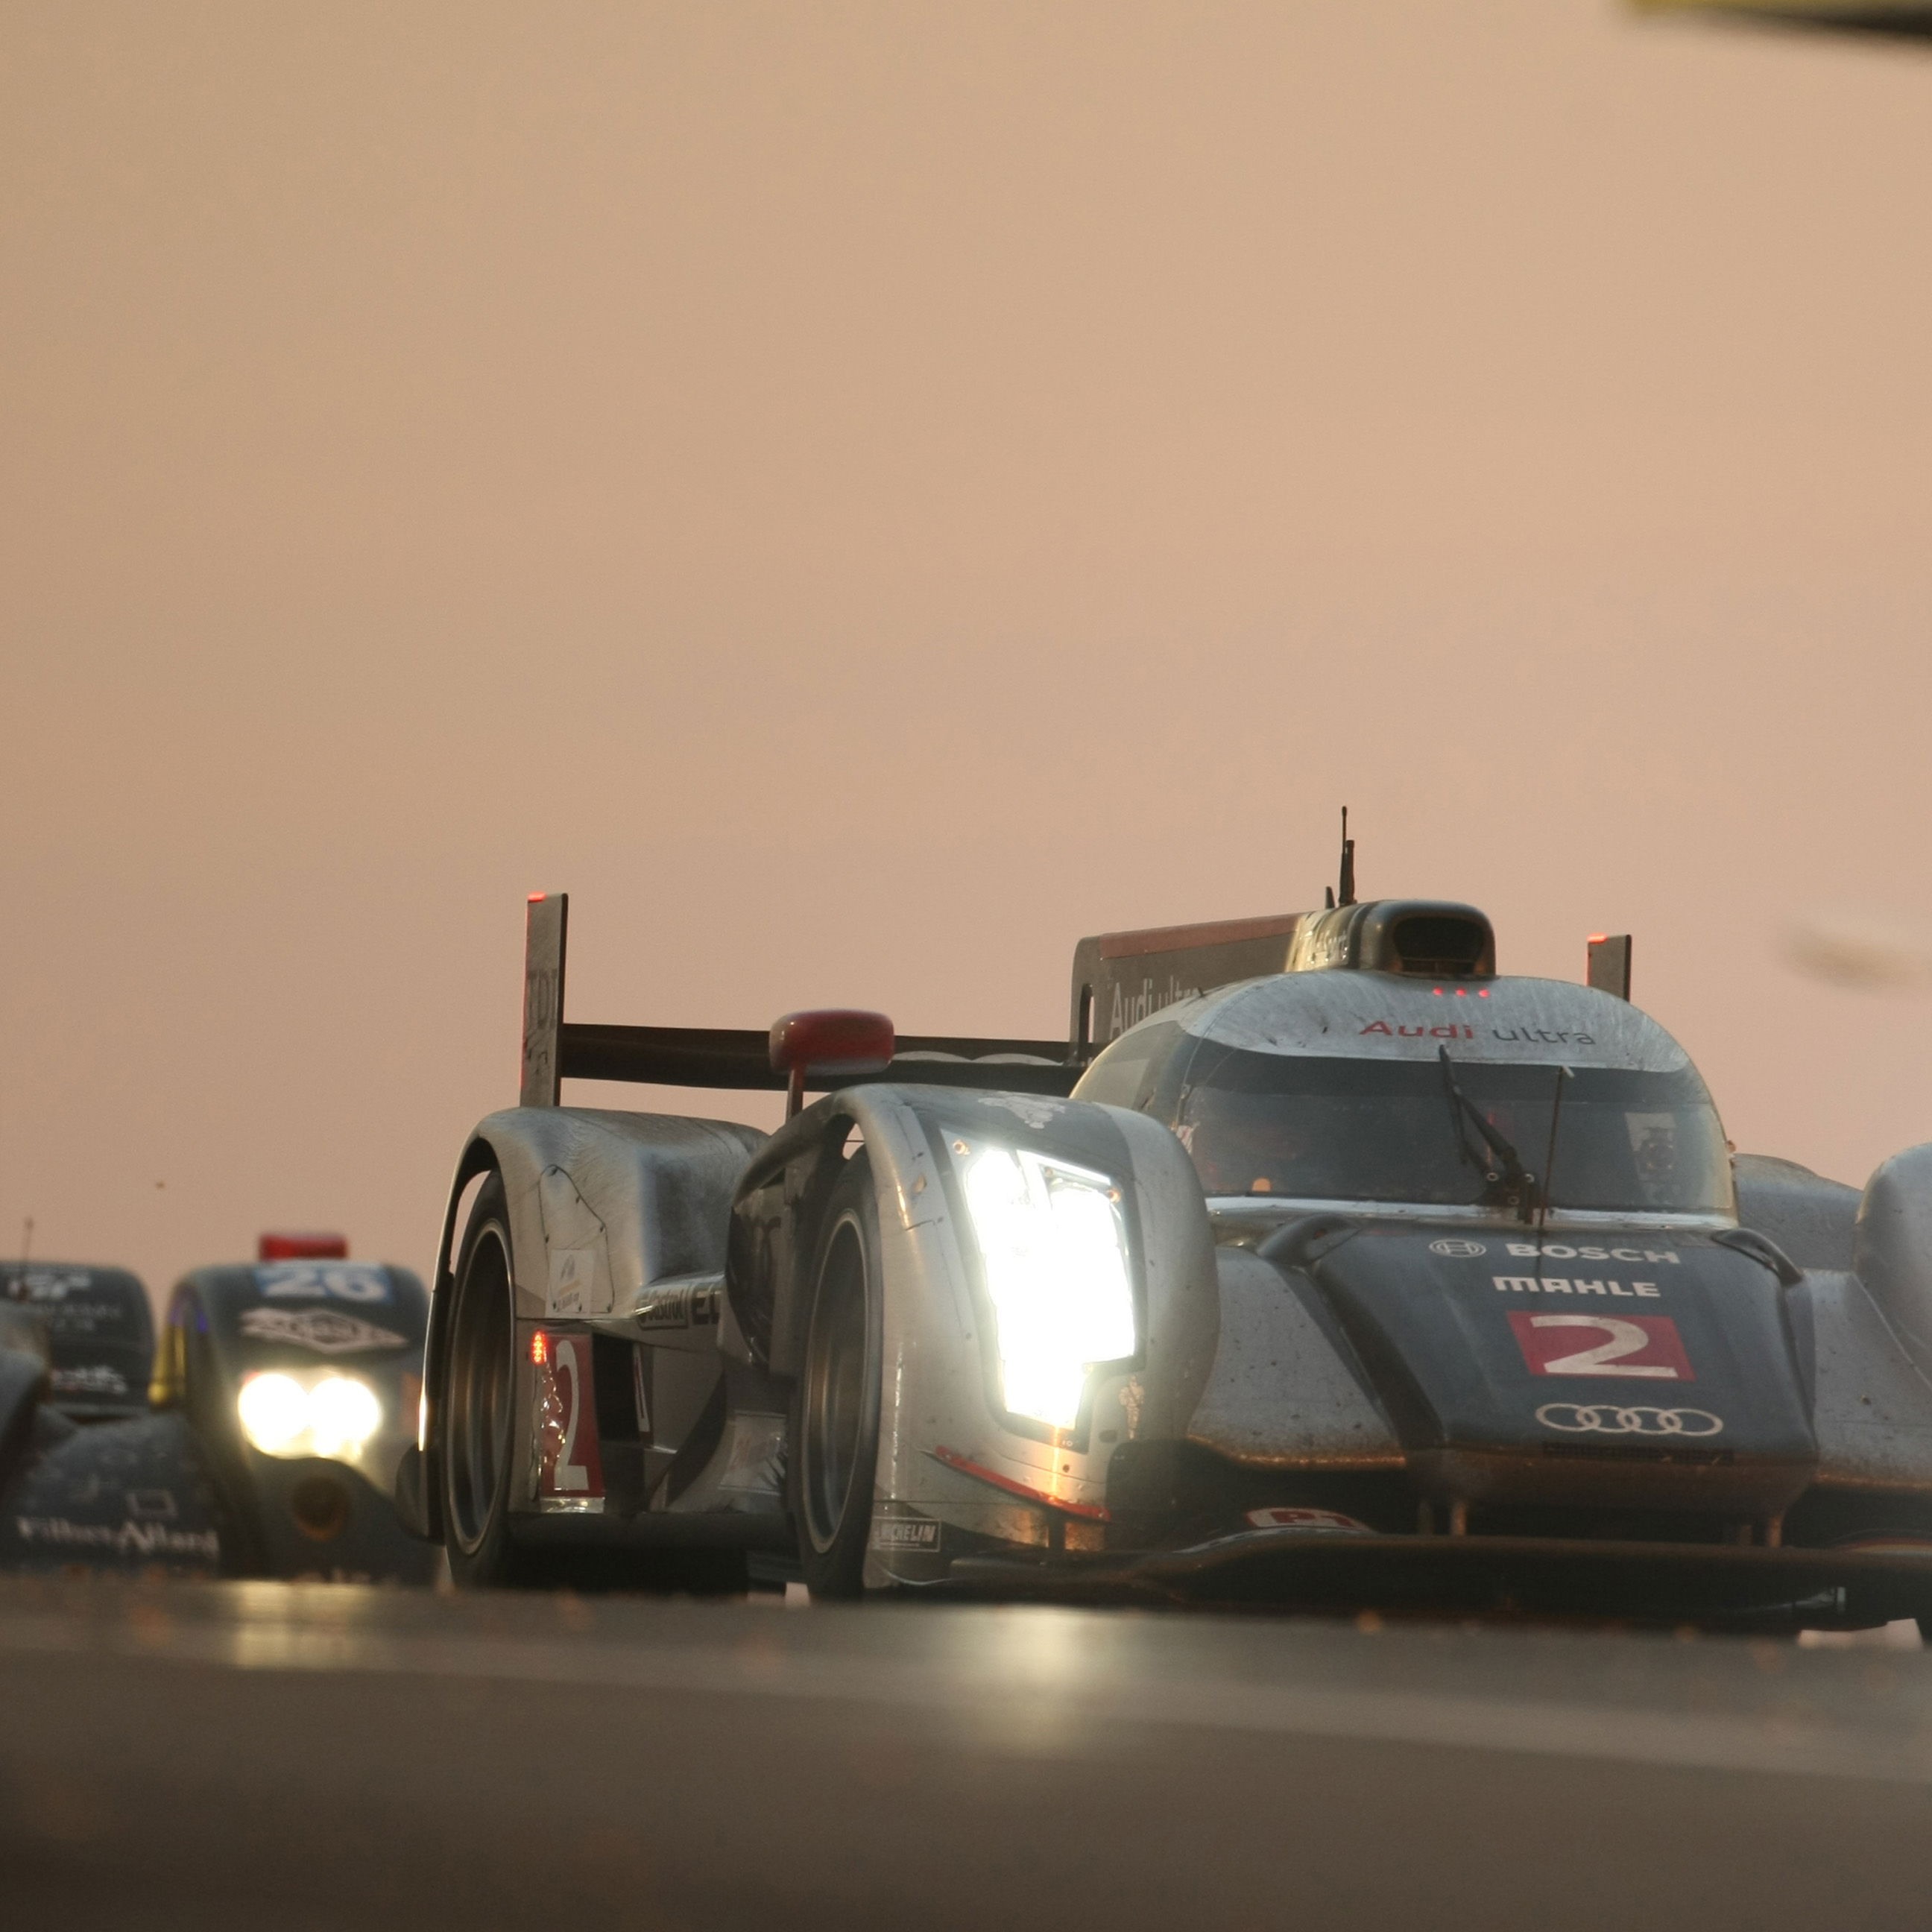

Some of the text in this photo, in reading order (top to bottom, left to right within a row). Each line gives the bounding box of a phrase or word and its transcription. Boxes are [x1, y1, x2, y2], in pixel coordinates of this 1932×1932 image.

[1109, 978, 1152, 1040] Audi
[1359, 1020, 1596, 1044] Audi ultra
[1505, 1243, 1681, 1264] BOSCH
[259, 1266, 387, 1301] 26
[1492, 1276, 1661, 1297] MAHLE
[1530, 1314, 1679, 1377] 2
[555, 1339, 590, 1491] 2
